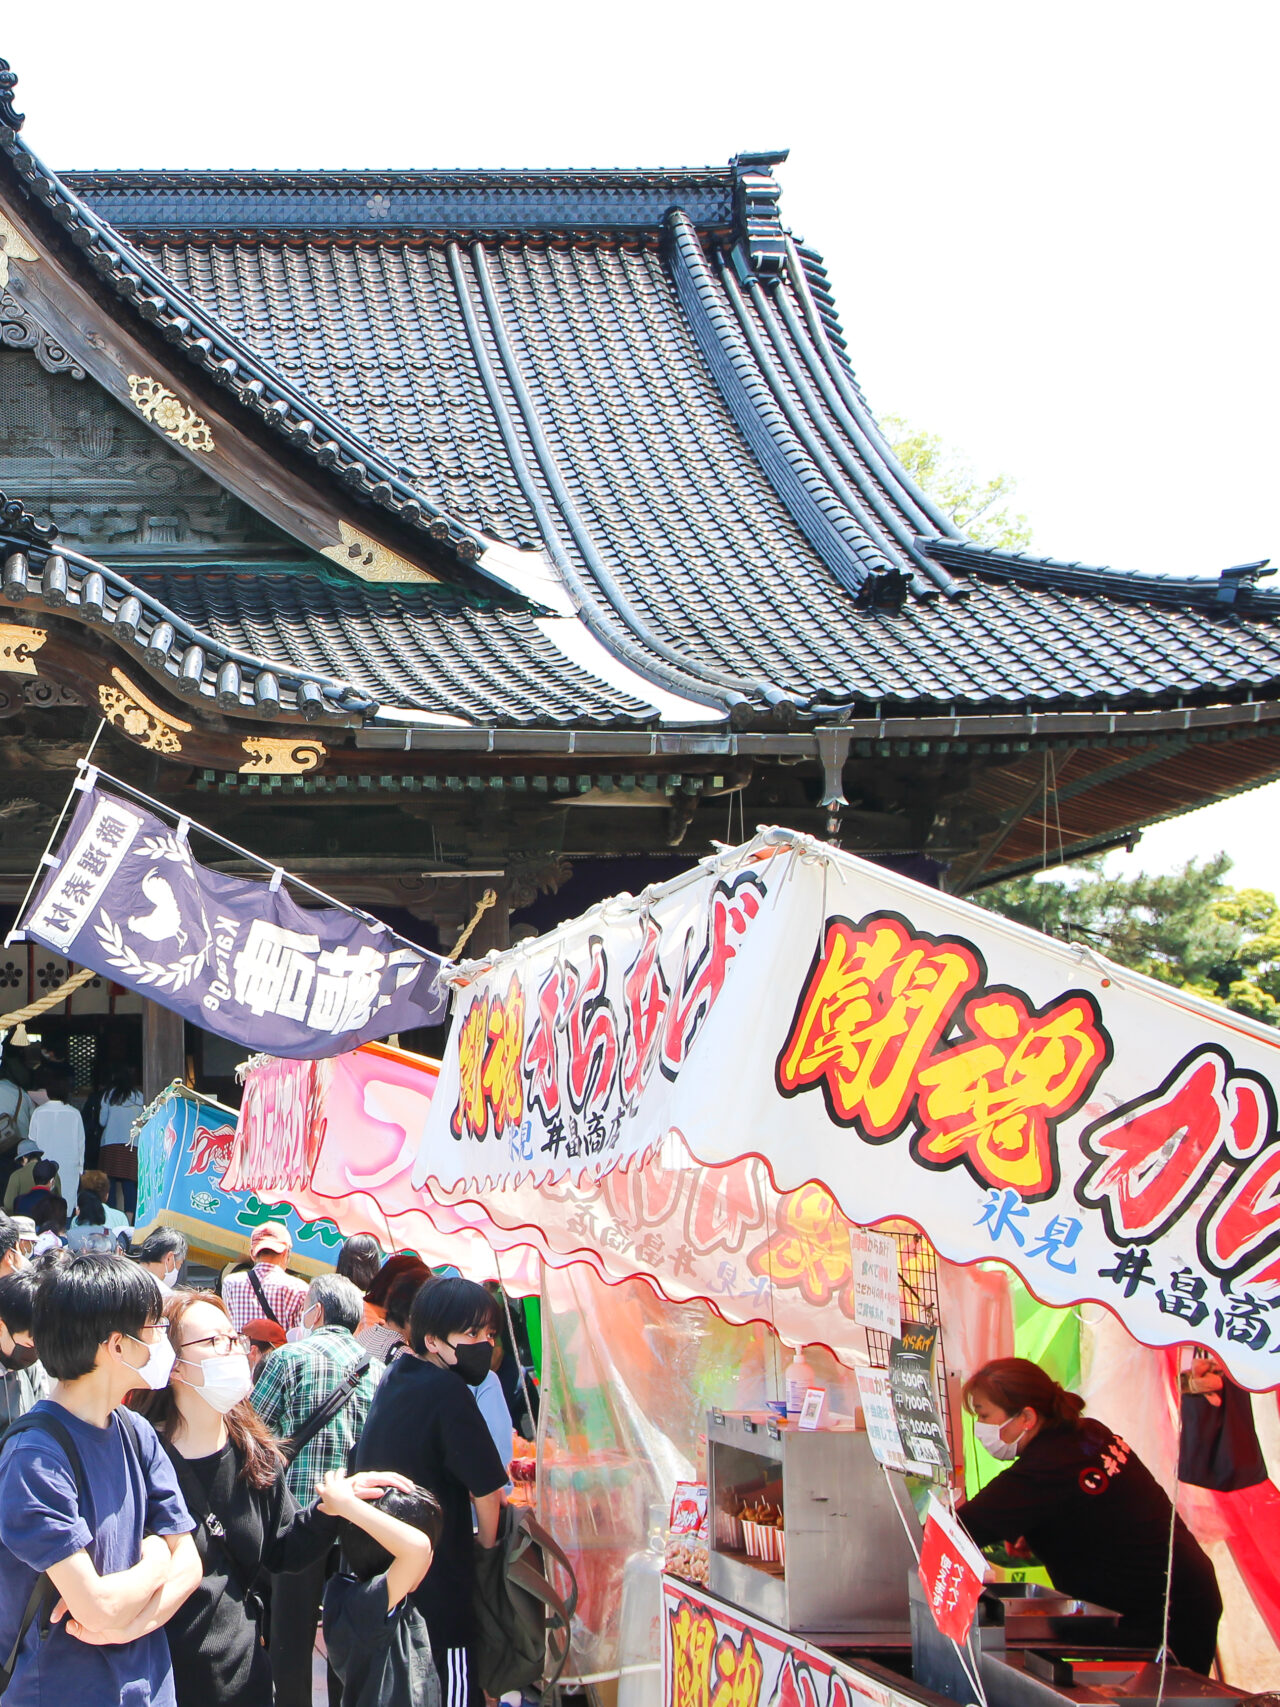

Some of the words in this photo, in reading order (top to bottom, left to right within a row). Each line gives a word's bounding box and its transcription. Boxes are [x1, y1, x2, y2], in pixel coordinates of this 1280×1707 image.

[973, 1188, 1084, 1274] 氷見
[1097, 1247, 1280, 1354] 井畠商
[946, 1563, 965, 1612] ペイペイ
